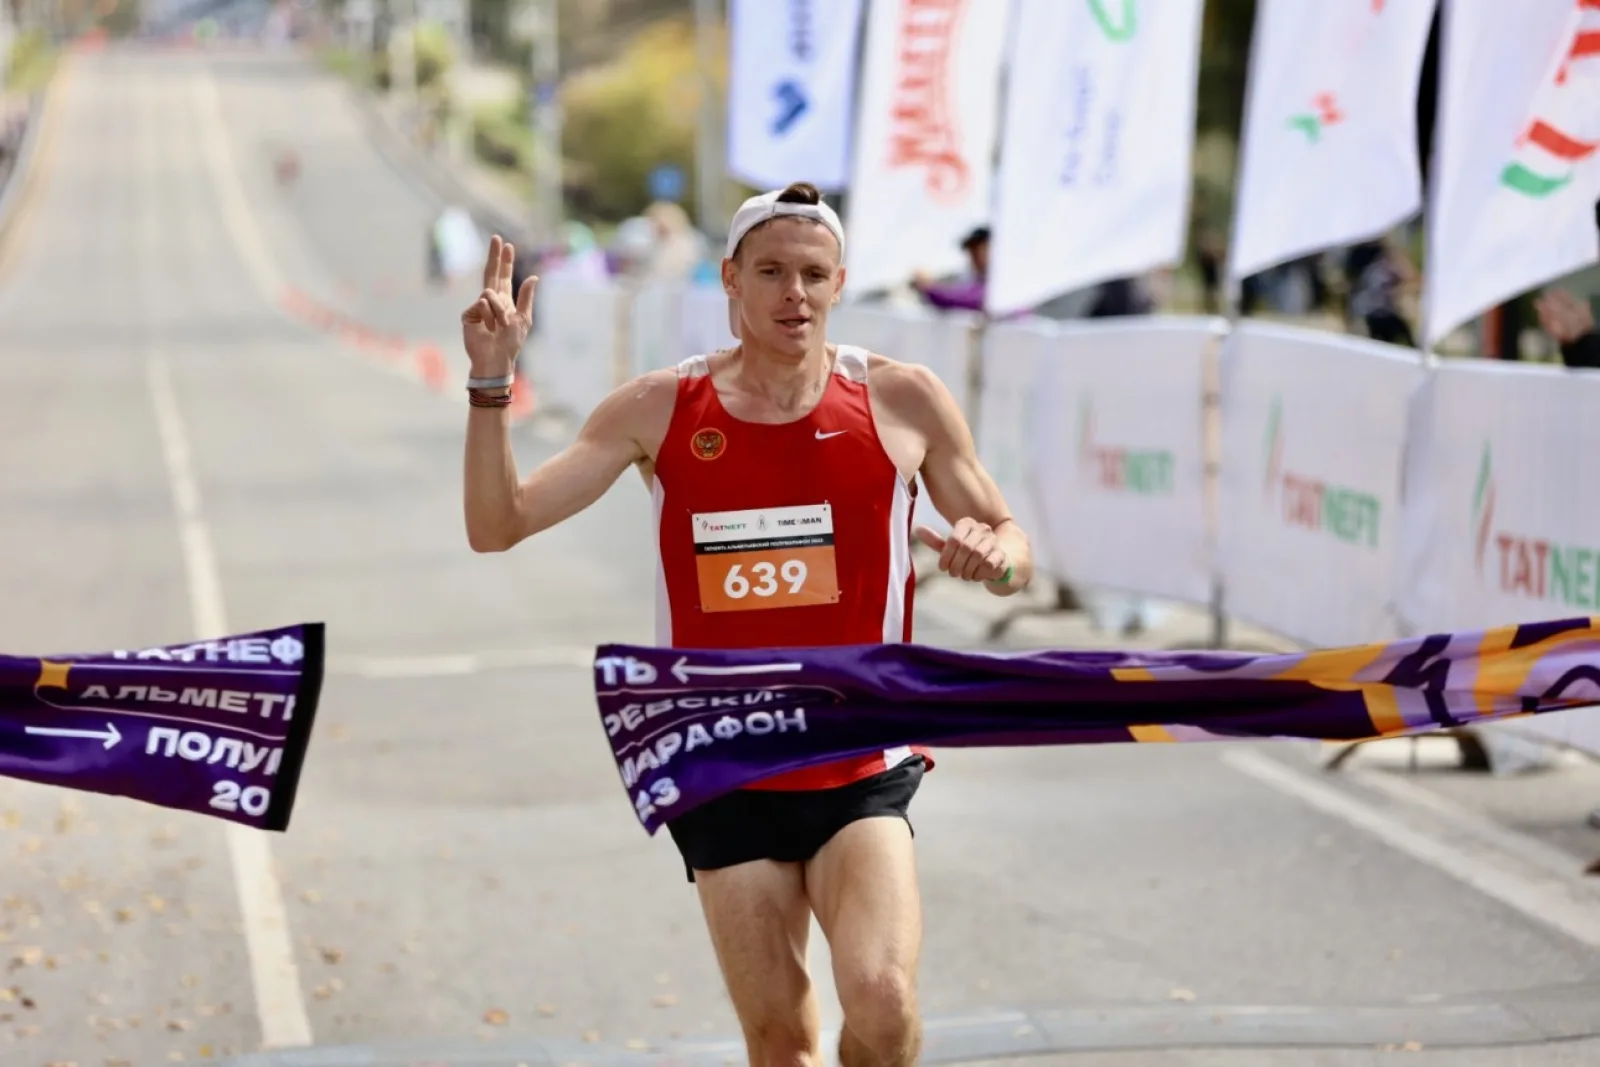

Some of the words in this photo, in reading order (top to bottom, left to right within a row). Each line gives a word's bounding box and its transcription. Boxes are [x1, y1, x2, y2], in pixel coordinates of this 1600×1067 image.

[1282, 470, 1381, 547] TATNEFT
[723, 559, 808, 599] 639
[1497, 535, 1600, 612] TATNE
[595, 656, 657, 685] ТЬ
[80, 685, 296, 721] АЛЬМЕТ
[145, 726, 283, 775] ПОЛУ
[209, 780, 270, 816] 20
